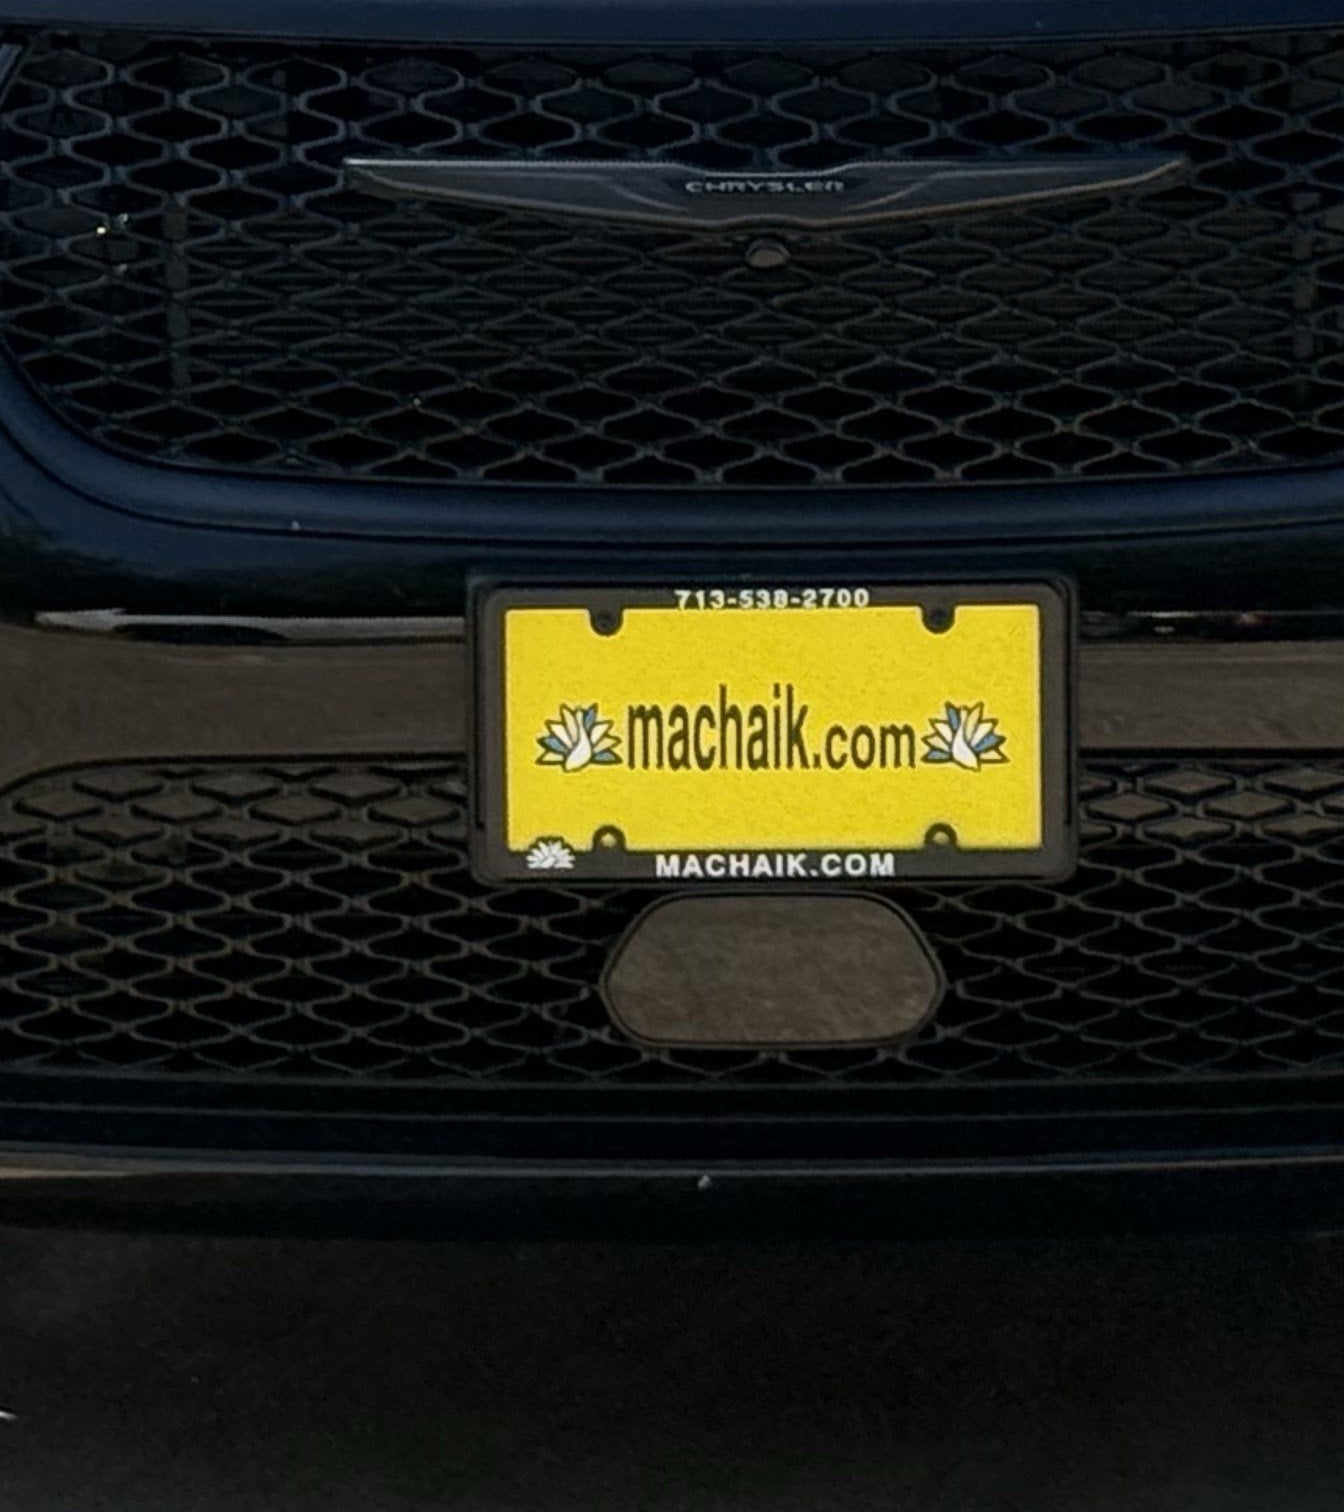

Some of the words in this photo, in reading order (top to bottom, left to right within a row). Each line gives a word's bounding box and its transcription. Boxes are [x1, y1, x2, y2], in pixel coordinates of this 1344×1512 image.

[685, 180, 845, 194] CHRYSLER
[674, 588, 870, 609] 713-538-2700
[627, 683, 917, 771] machaik.com
[655, 852, 895, 879] MACHAIK.COM
